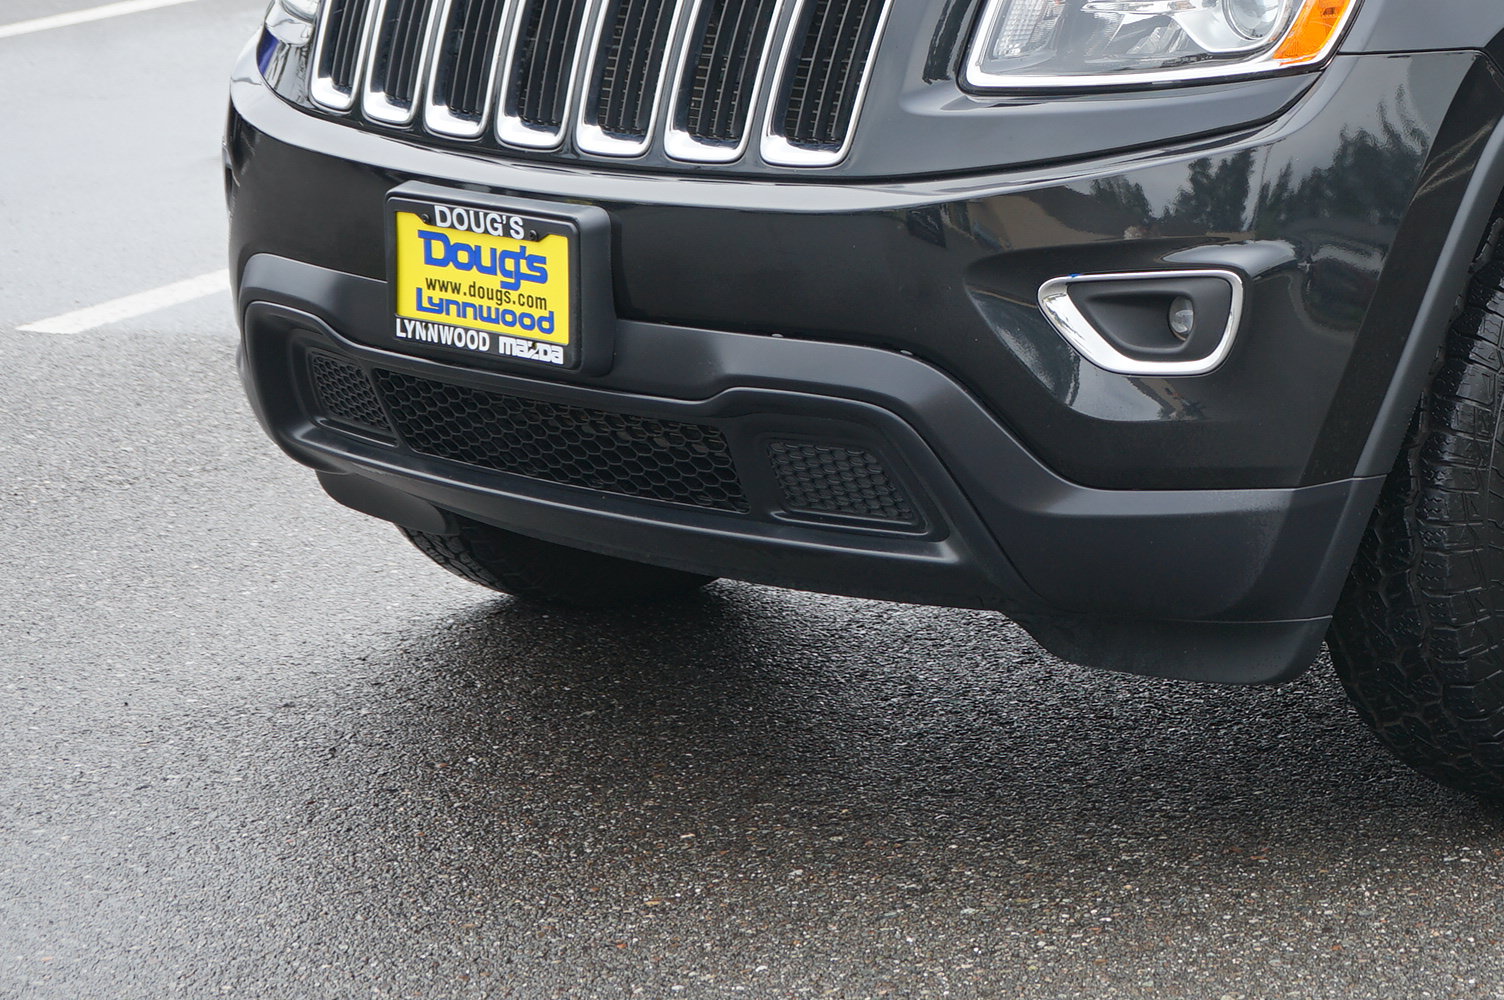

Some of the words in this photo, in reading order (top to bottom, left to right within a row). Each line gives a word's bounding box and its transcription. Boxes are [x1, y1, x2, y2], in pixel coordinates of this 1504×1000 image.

[434, 205, 524, 240] DOUG'S
[418, 230, 548, 291] Doug's
[416, 287, 554, 334] Lynnwood
[425, 278, 547, 310] www.dougs.com
[396, 318, 489, 351] LYNNWOOD
